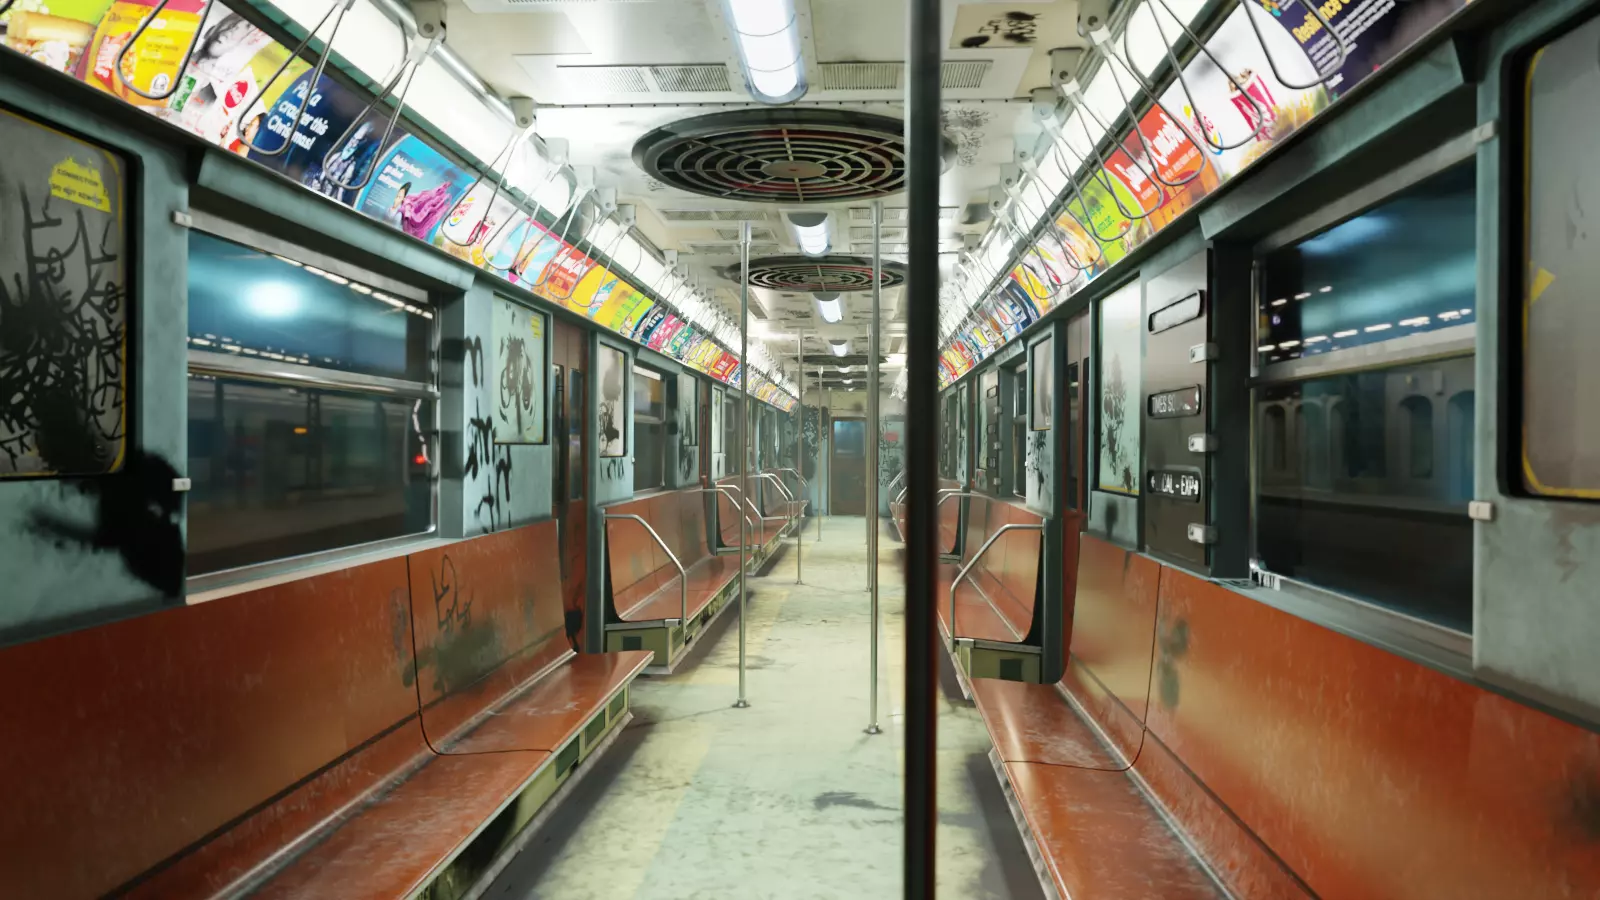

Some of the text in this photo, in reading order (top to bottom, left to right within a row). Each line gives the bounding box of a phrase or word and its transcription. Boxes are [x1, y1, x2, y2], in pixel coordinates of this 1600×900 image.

[267, 114, 316, 150] Chrismas!
[278, 100, 329, 136] cracer this
